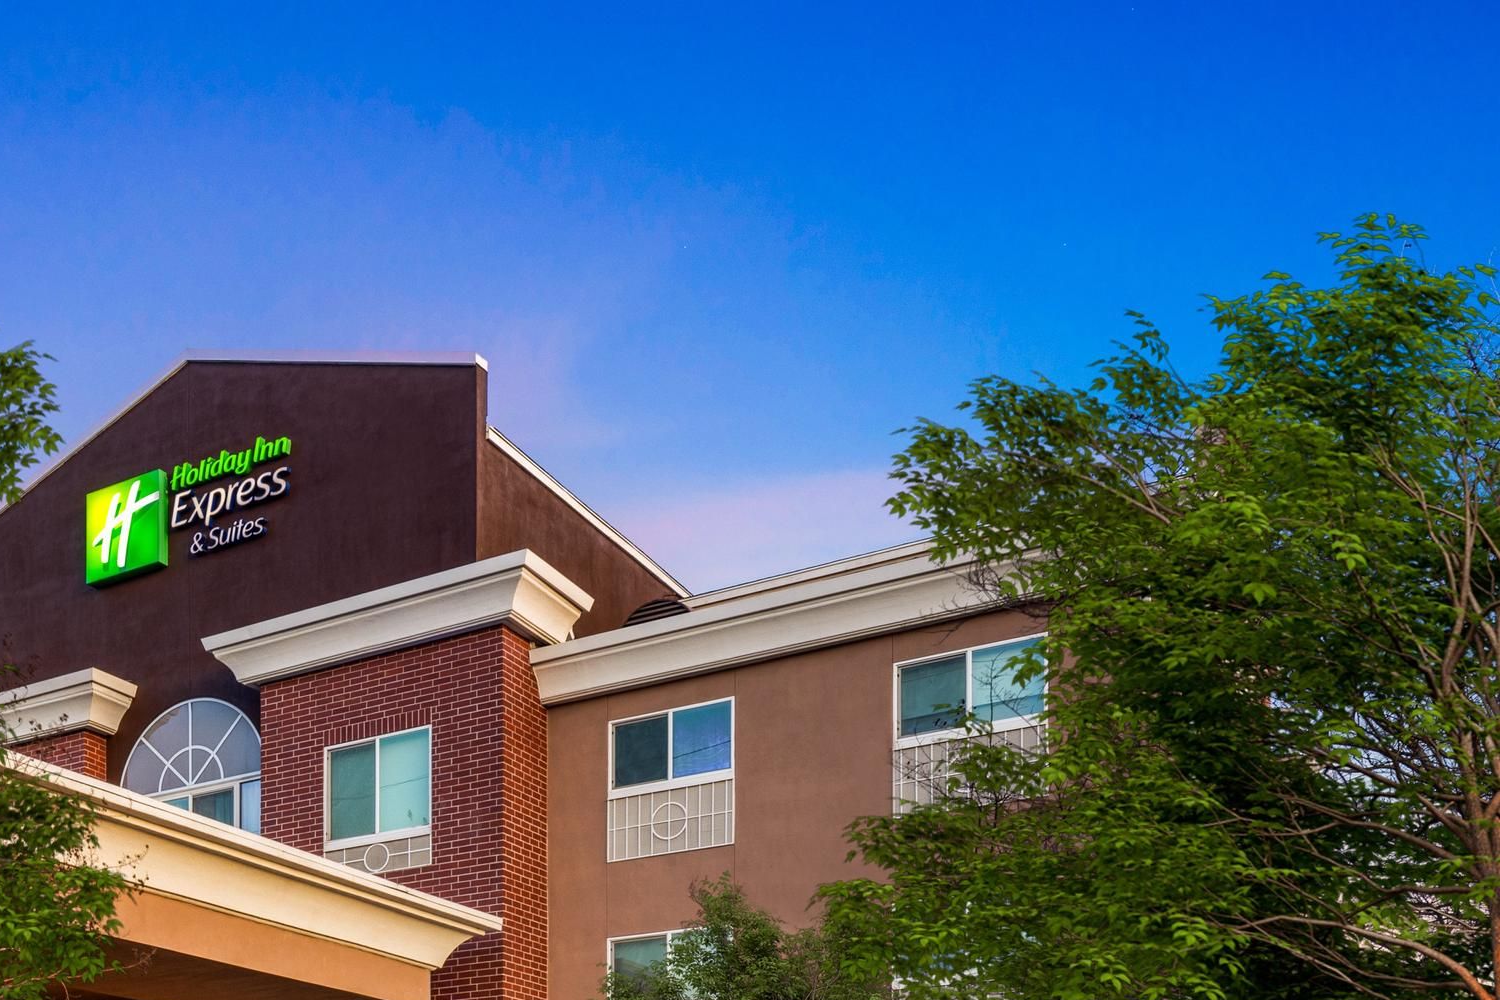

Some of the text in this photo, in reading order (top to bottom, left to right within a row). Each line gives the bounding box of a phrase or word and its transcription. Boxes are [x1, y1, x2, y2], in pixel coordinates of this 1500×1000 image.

[170, 436, 292, 491] Holiday Inn
[171, 466, 289, 528] Express
[190, 517, 265, 554] & Suites
